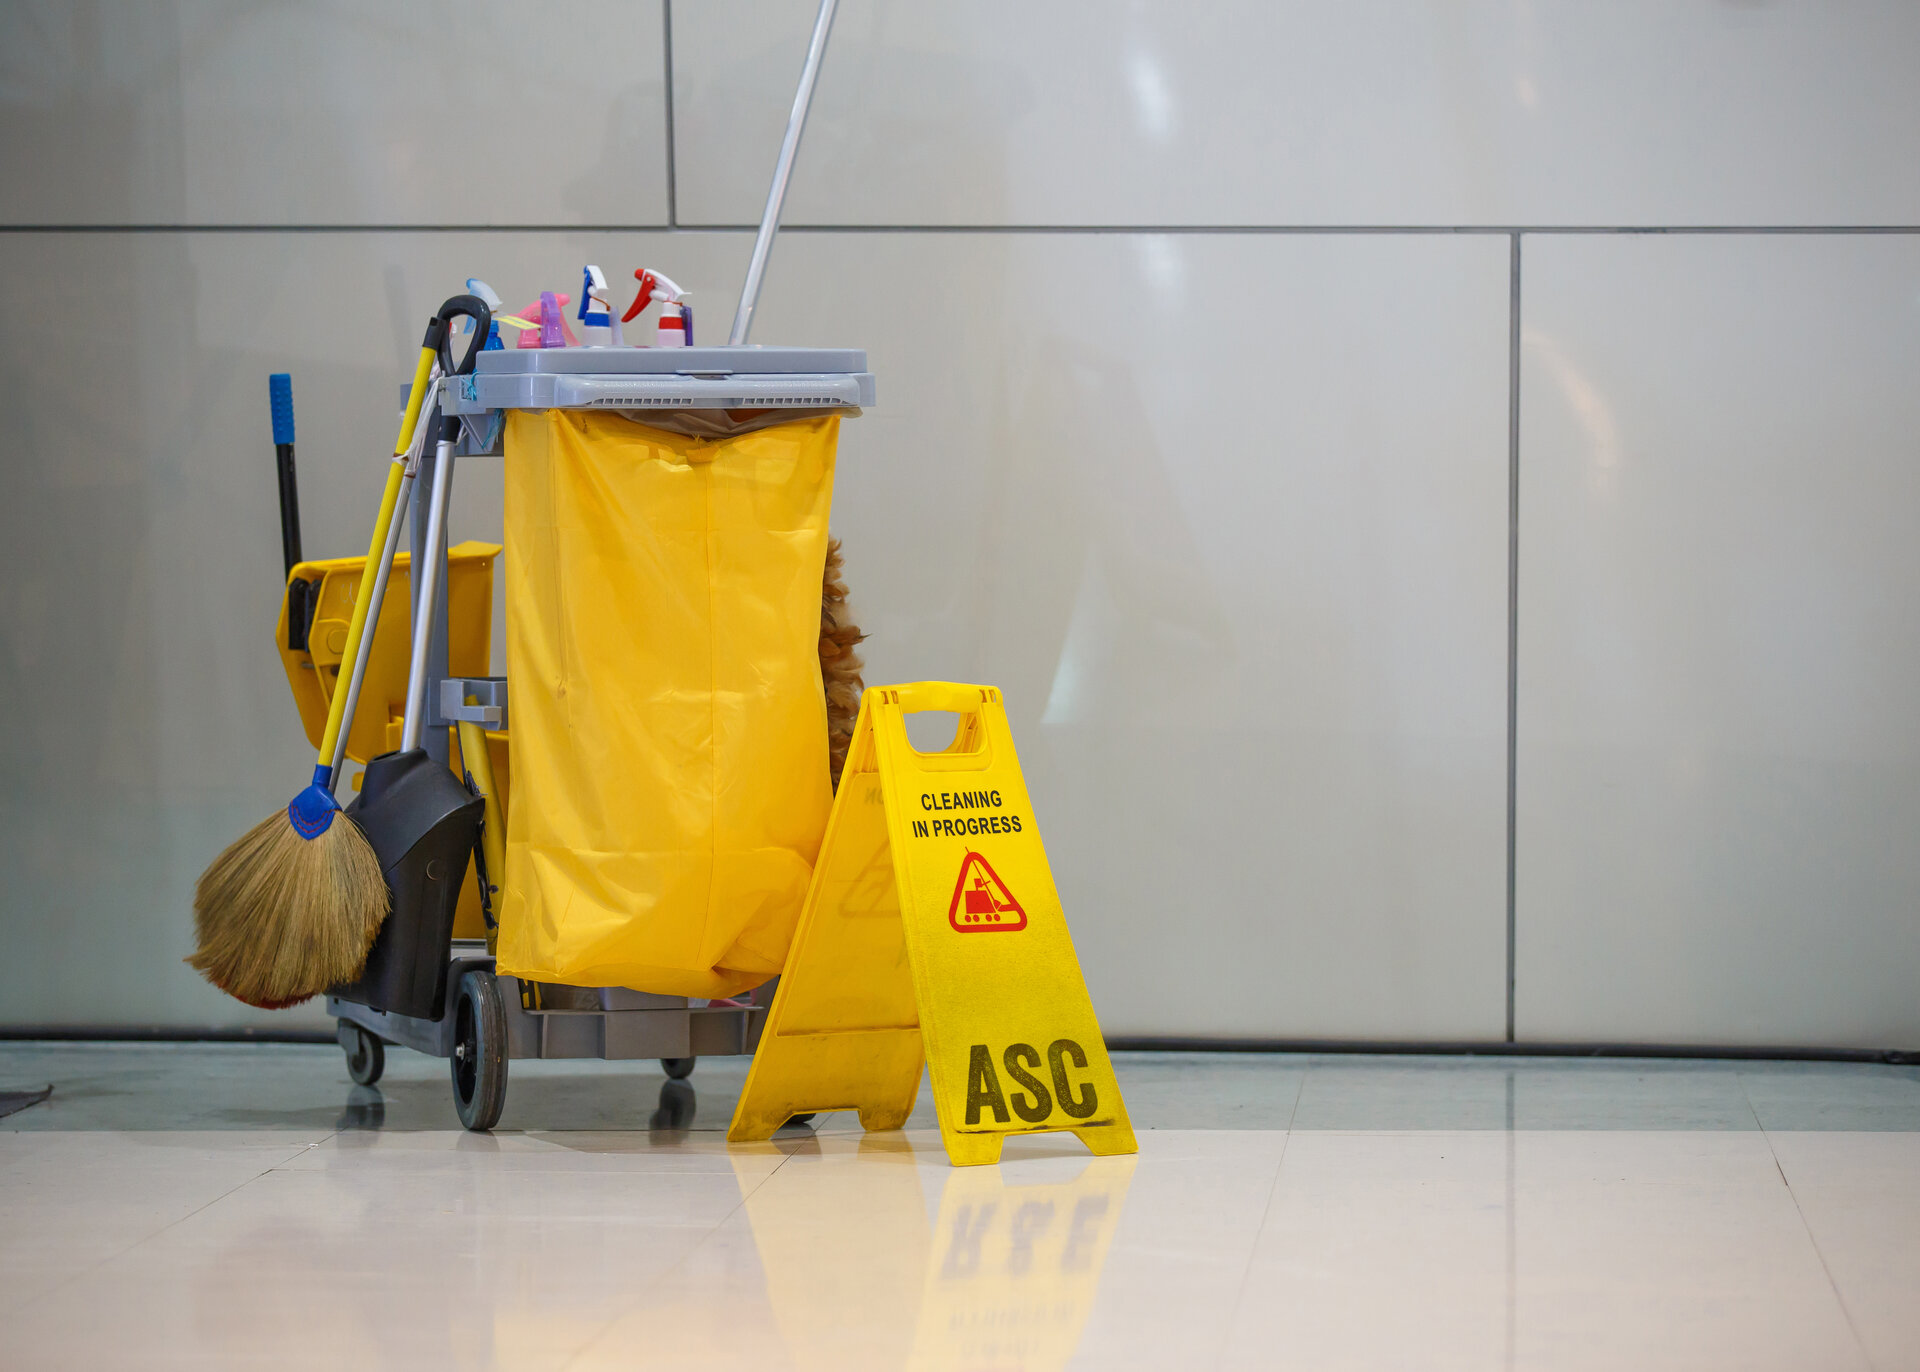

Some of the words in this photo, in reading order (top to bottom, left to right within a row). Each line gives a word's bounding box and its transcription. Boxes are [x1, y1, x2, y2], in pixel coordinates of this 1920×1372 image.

[921, 790, 1002, 811] CLEANING
[912, 820, 929, 838] IN
[932, 815, 1022, 837] PROGRESS
[965, 1039, 1098, 1125] ASC
